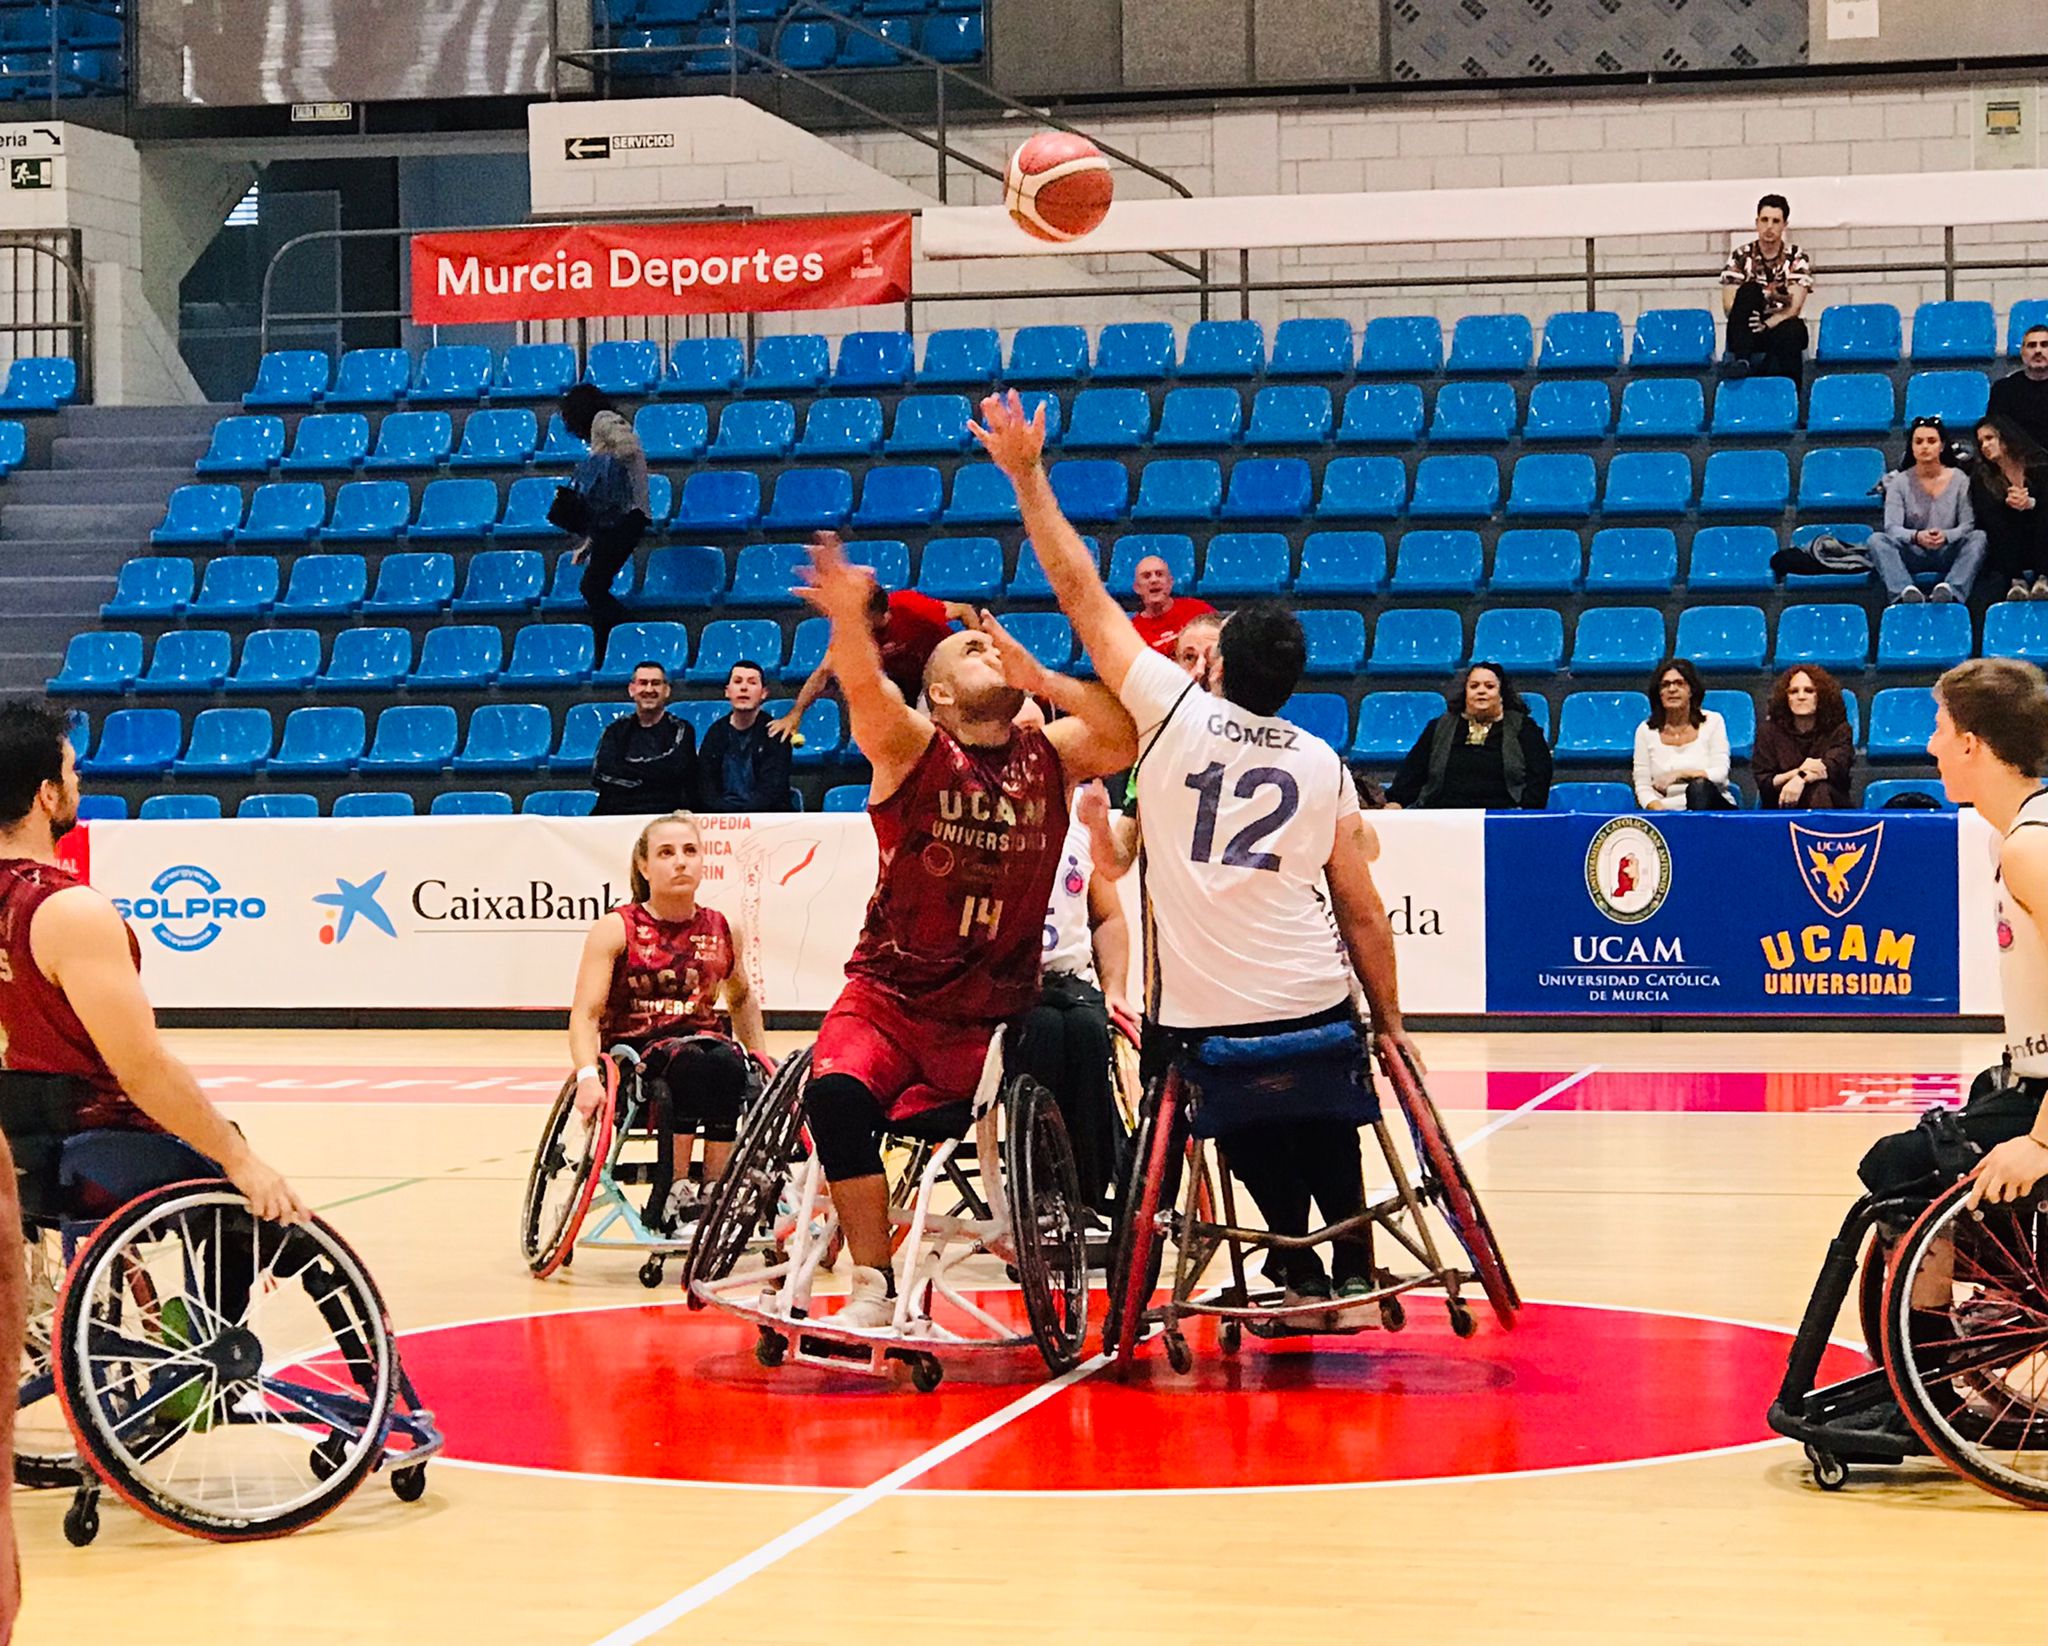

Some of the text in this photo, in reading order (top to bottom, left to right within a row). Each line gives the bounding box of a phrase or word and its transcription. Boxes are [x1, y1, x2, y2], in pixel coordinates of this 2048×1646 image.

[613, 134, 673, 149] SERVICIOS
[437, 247, 824, 296] Murcia Deportes
[1207, 713, 1301, 751] GOMEZ
[1184, 760, 1300, 873] 12
[1816, 841, 1857, 851] UCAM
[411, 879, 623, 921] CaixaBank
[958, 894, 1004, 941] 14
[1573, 936, 1687, 963] UCAM
[1760, 924, 1916, 971] UCAM
[1538, 972, 1721, 987] UNIVERSIDAD CATÓLICA
[1611, 989, 1670, 1002] MURCIA
[1764, 972, 1912, 995] UNIVERSIDAD
